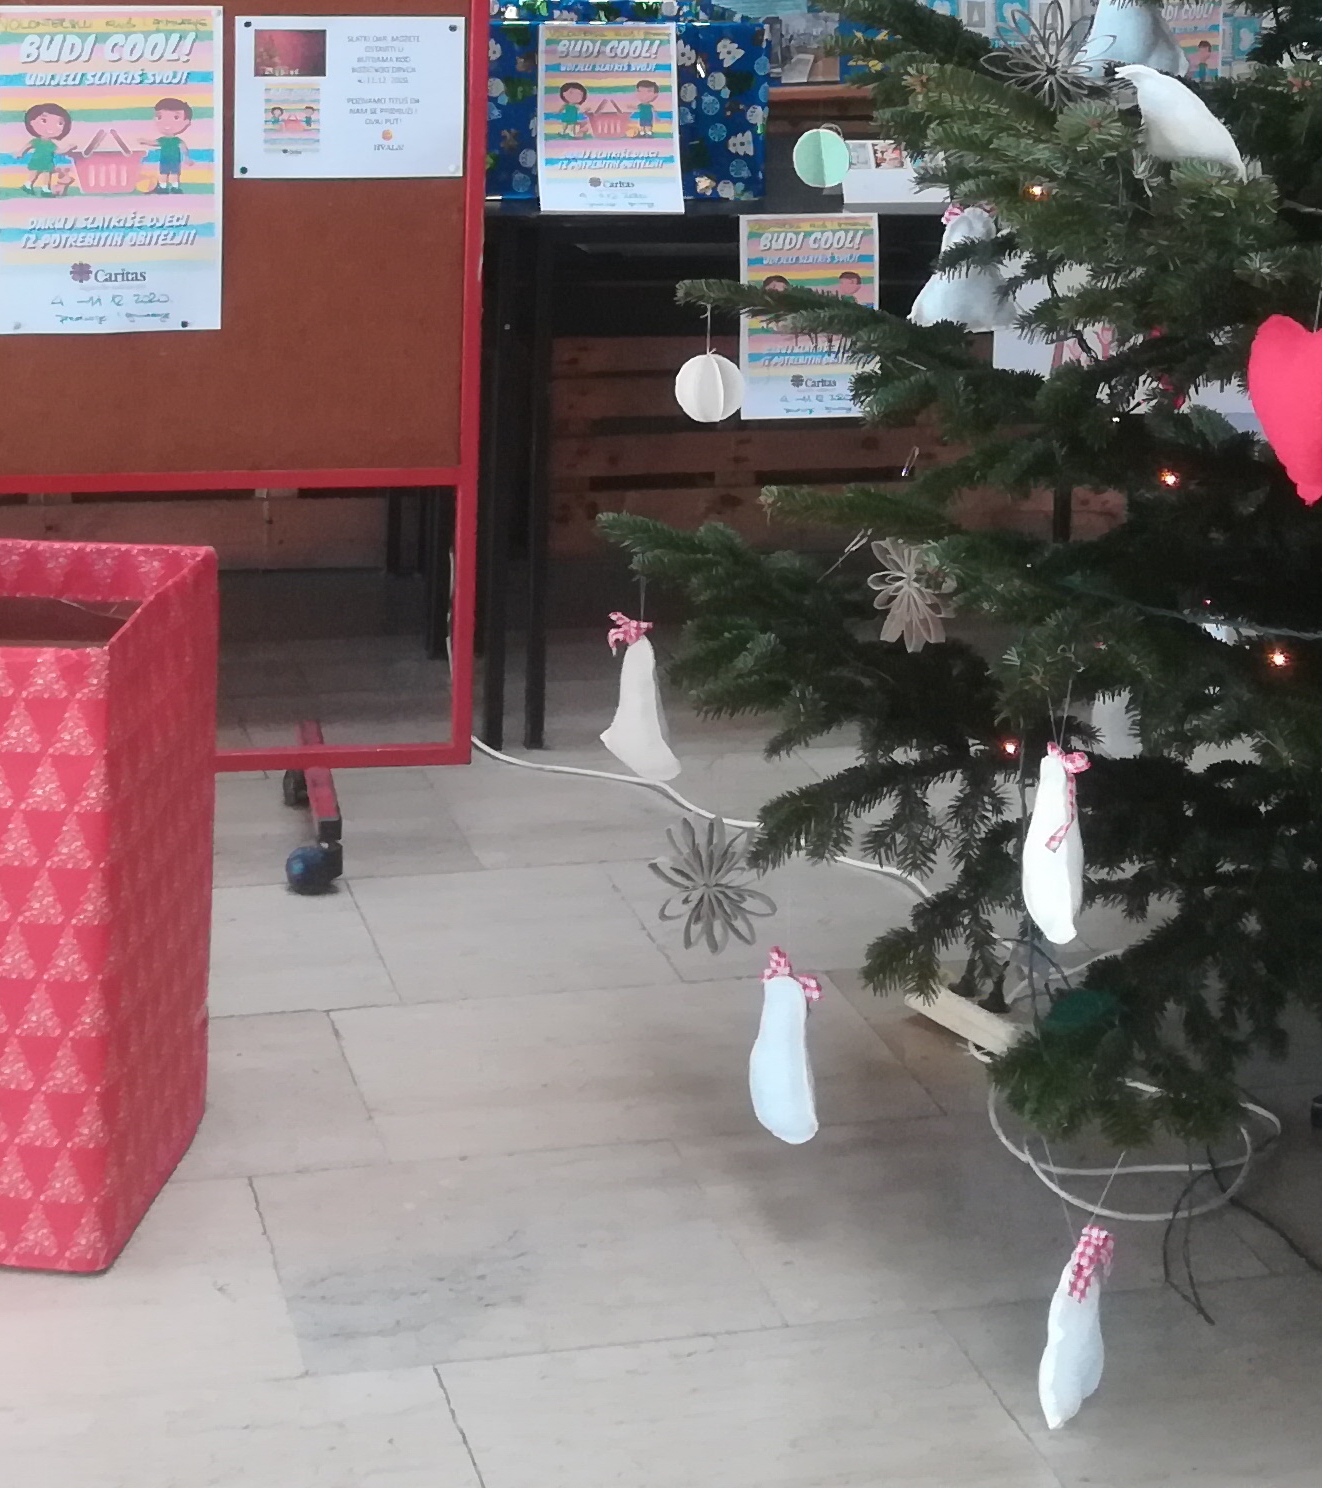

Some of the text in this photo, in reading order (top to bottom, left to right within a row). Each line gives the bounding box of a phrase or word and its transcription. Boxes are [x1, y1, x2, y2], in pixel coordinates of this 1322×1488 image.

[20, 31, 198, 63] BUDI COOL!
[558, 39, 661, 59] BUDI COOL!
[25, 72, 83, 86] UDIJELI
[84, 68, 145, 86] SLATKIŠ
[603, 180, 635, 188] Caritas
[760, 230, 864, 251] BUDI COOL!
[94, 268, 147, 283] Caritas
[805, 379, 837, 388] Caritas
